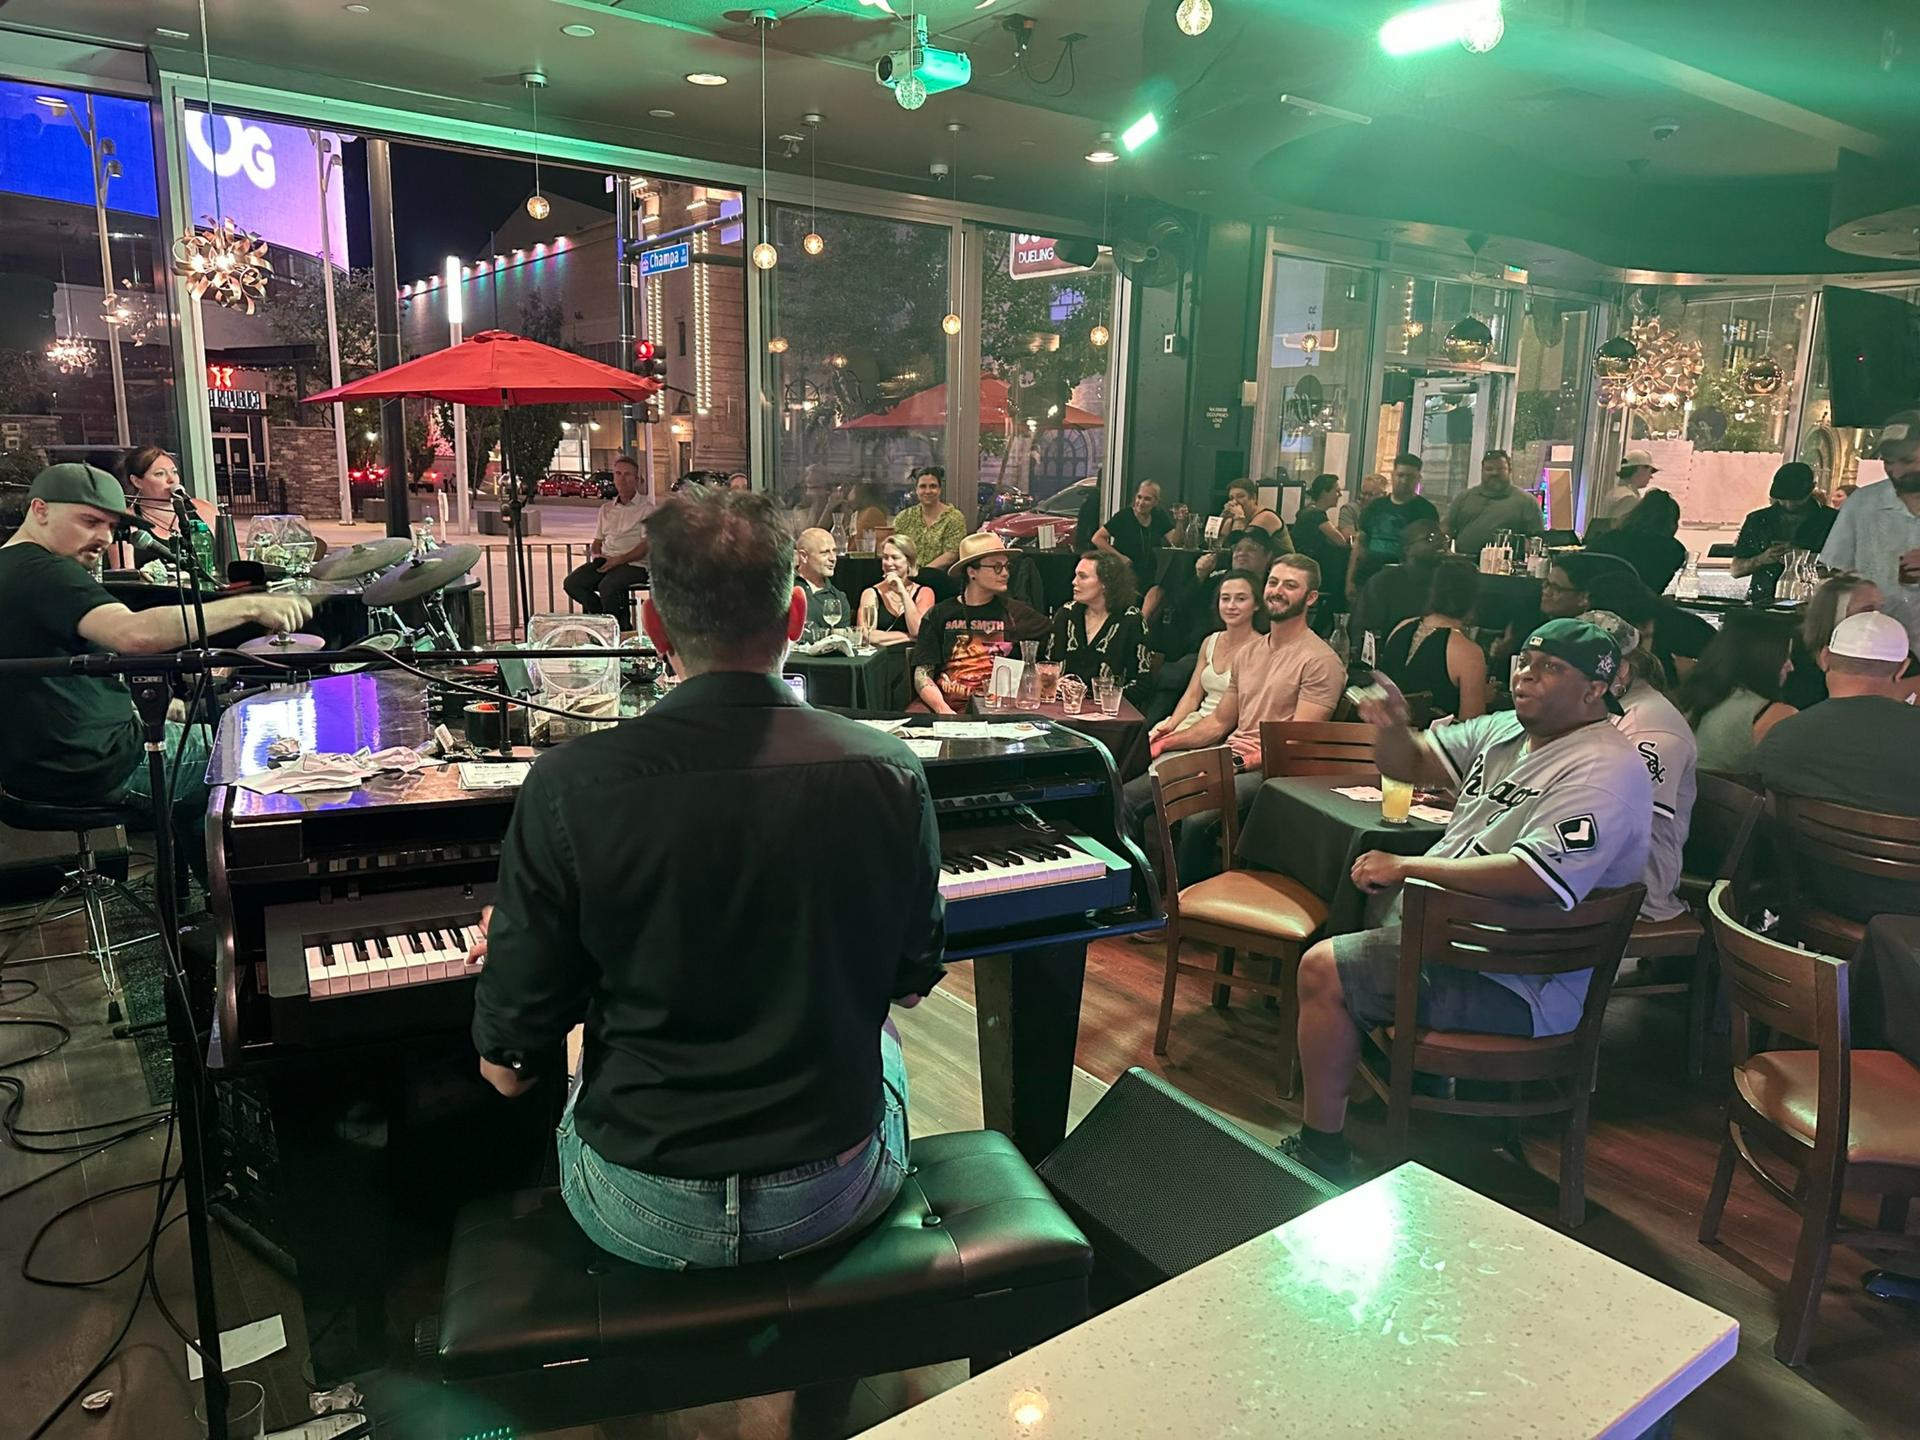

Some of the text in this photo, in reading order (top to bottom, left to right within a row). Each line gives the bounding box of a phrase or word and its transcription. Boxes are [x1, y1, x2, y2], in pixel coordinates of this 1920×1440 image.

[650, 251, 679, 268] Champa
[1018, 246, 1055, 264] DUELING
[945, 620, 967, 630] SAM
[1637, 740, 1666, 784] Sox
